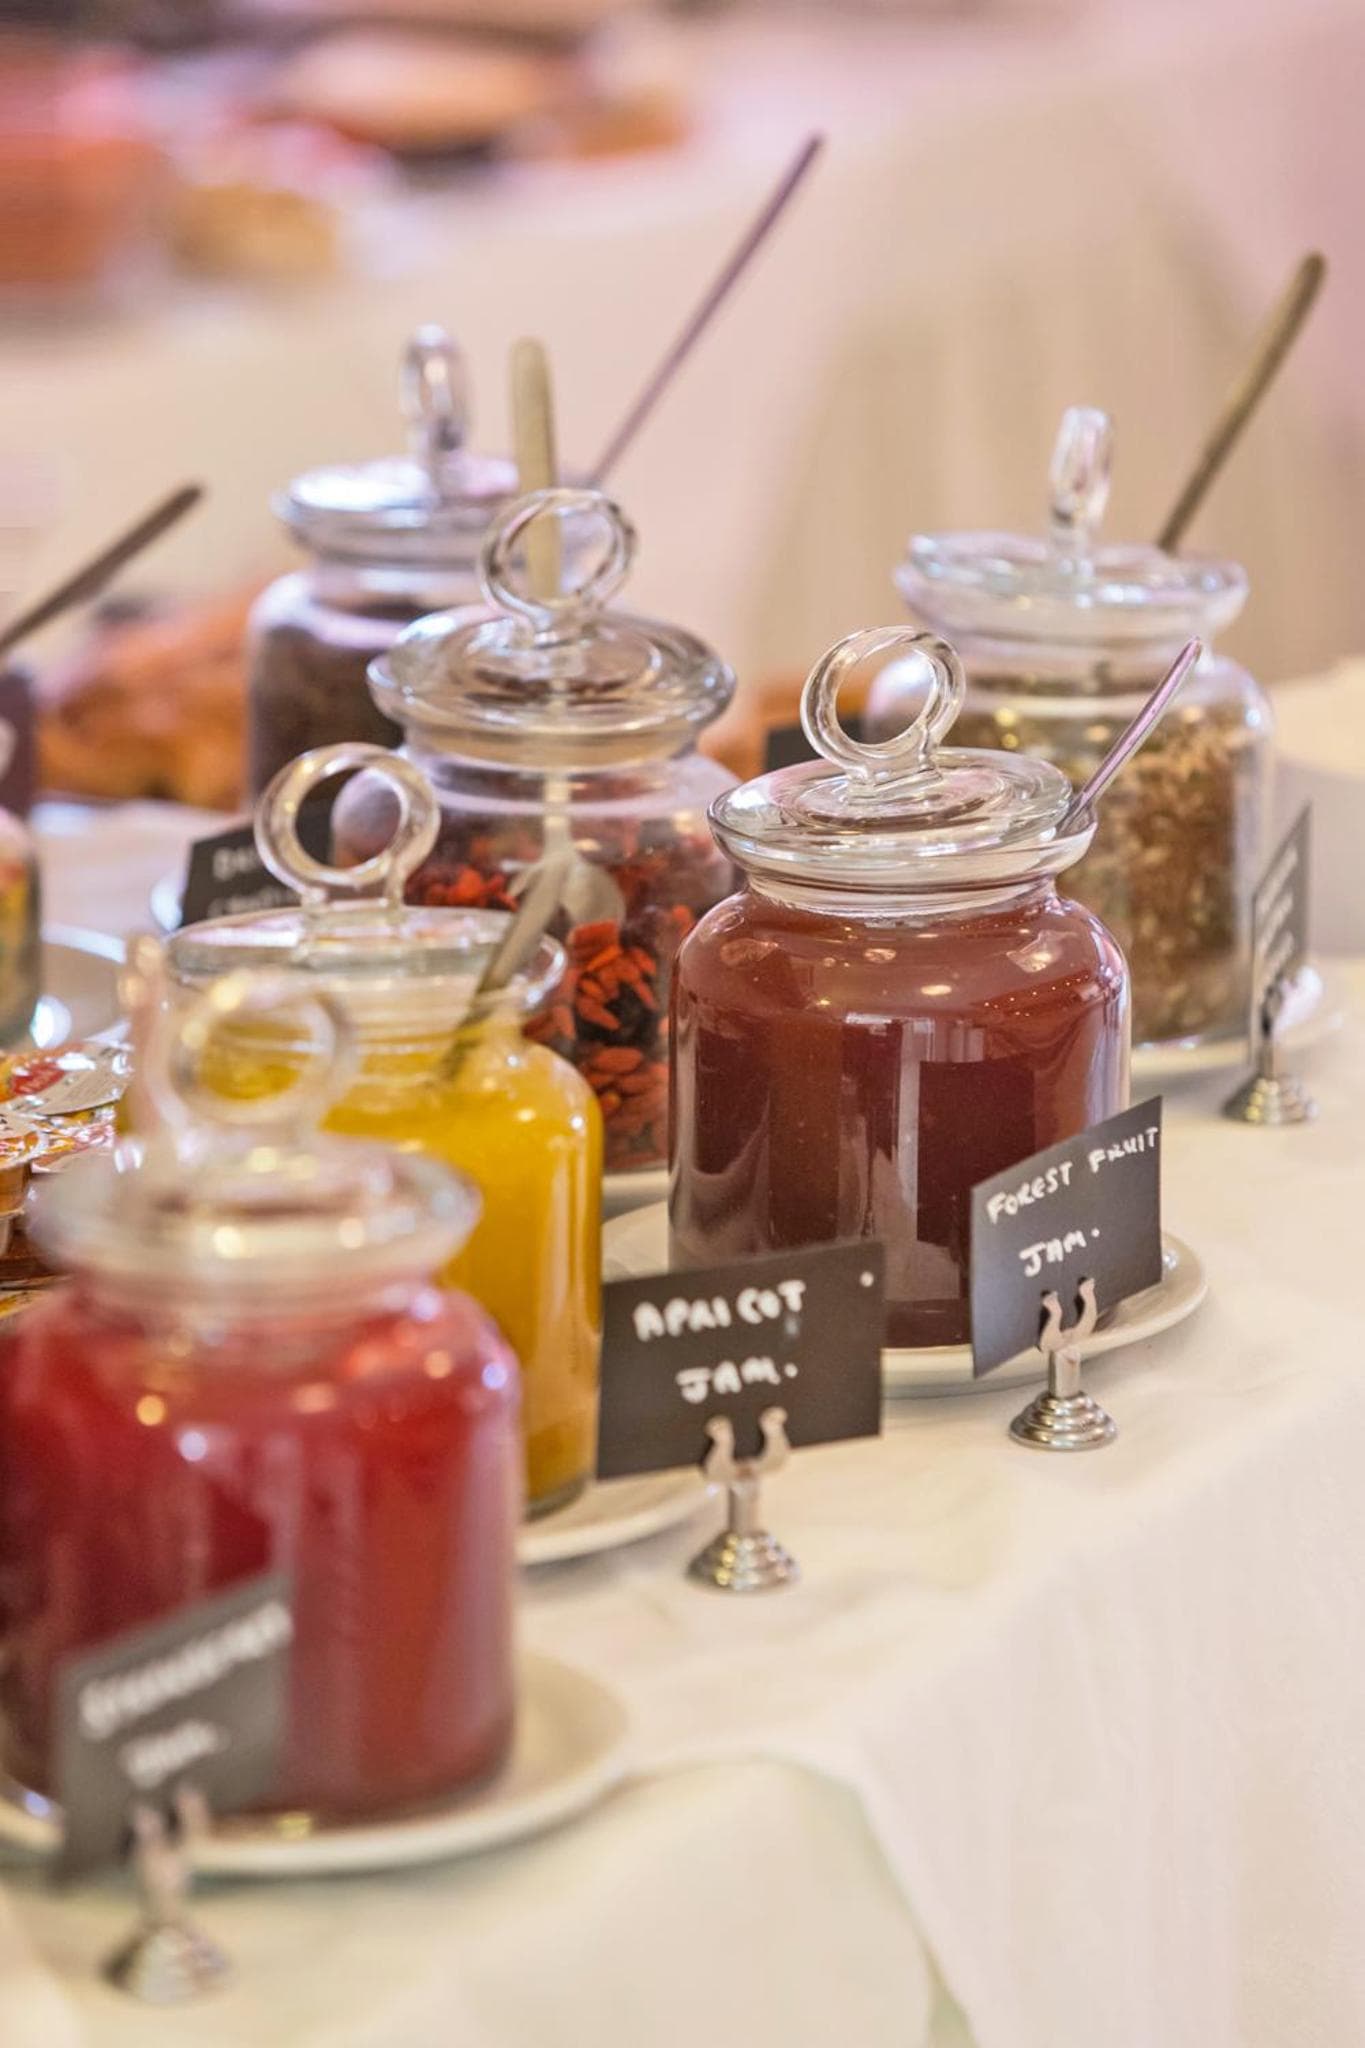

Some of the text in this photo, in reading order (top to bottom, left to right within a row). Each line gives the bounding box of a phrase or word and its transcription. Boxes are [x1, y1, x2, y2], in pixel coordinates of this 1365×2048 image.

[986, 1127, 1159, 1224] FOREST FRUIT
[633, 1279, 806, 1342] APRICOT
